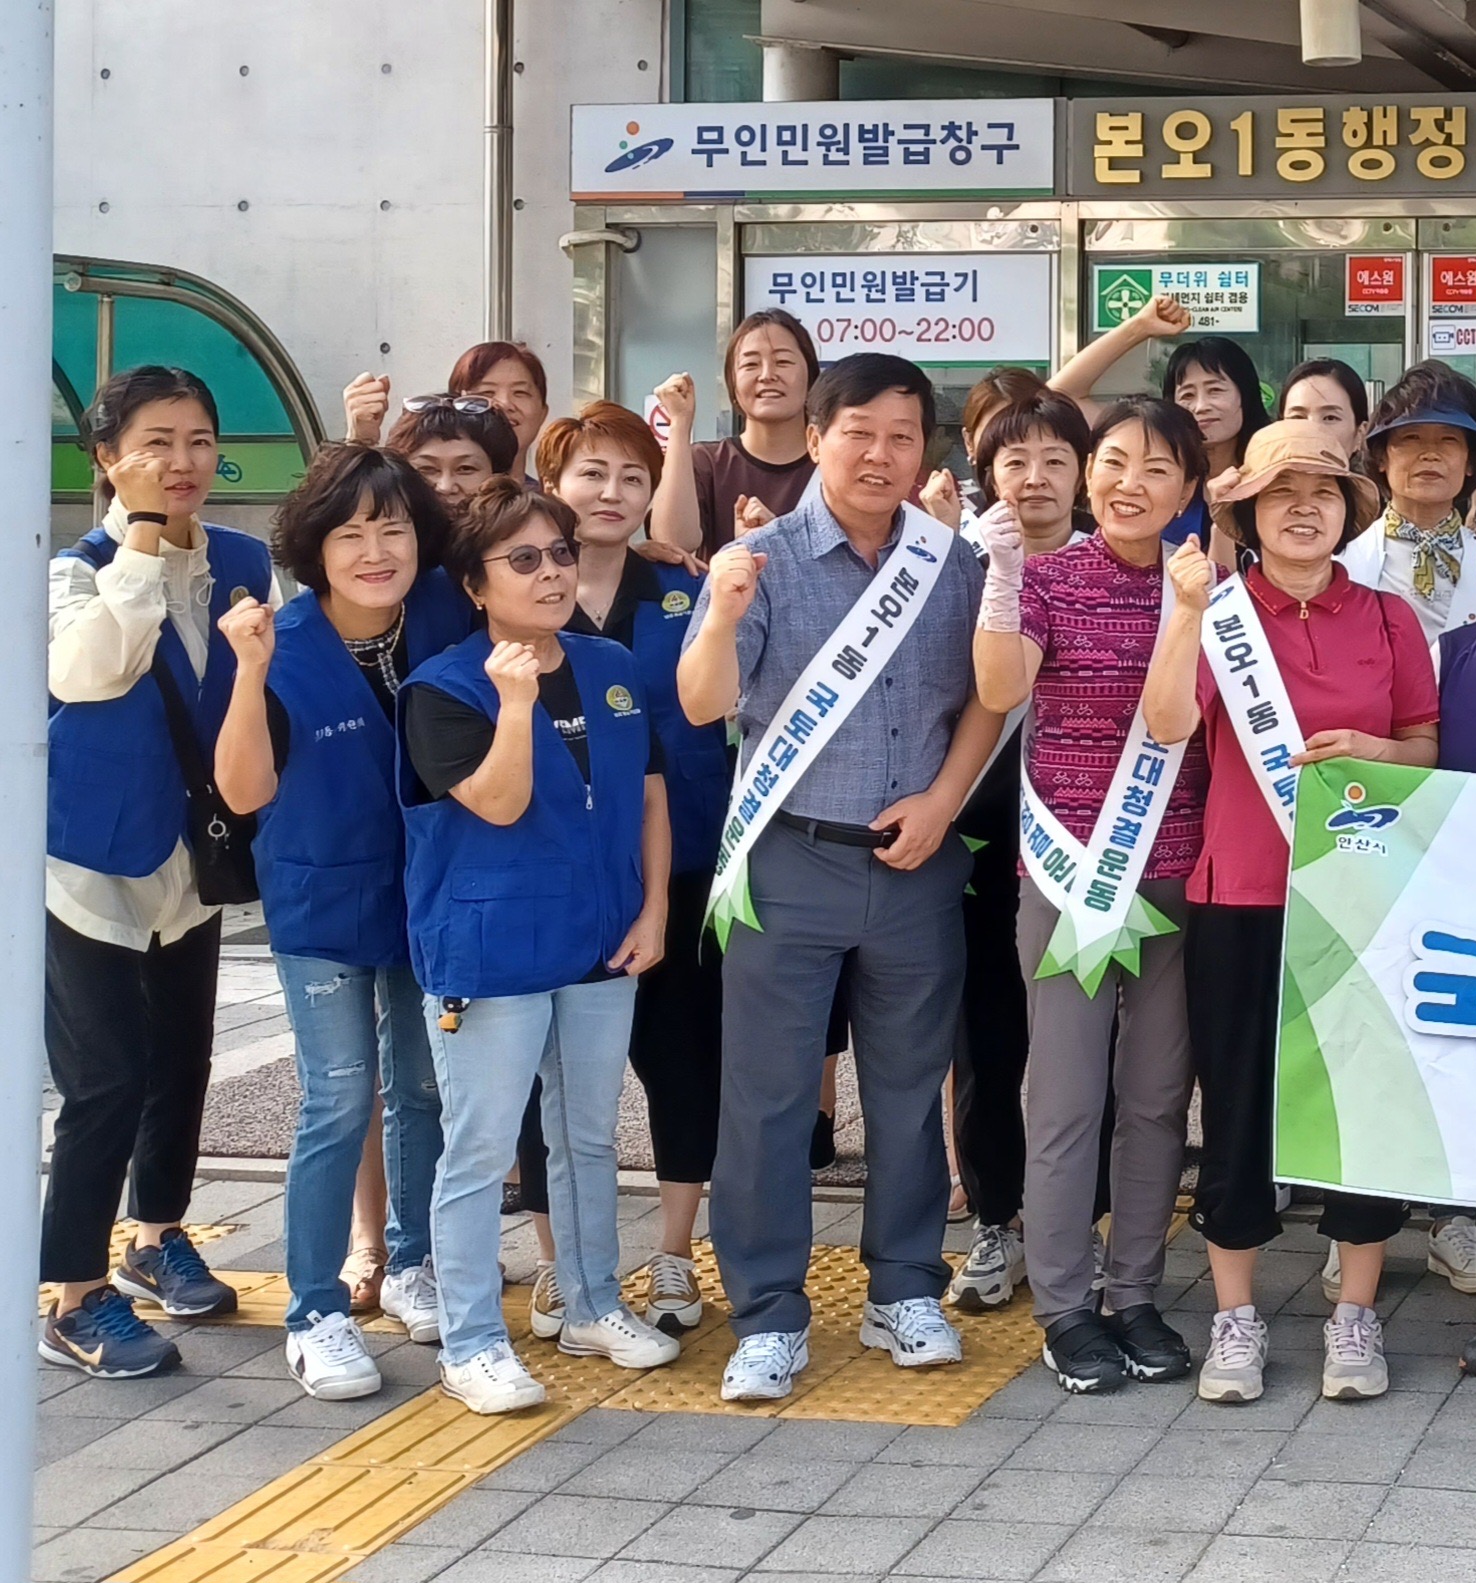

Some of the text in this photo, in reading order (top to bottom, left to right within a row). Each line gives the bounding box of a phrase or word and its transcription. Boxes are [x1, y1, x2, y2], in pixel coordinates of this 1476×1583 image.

[691, 120, 1021, 169] 무인민원발급창구
[768, 268, 980, 305] 무인민원발급기
[1158, 270, 1249, 288] 무더위 쉼터
[1356, 270, 1395, 286] 에스원
[1348, 304, 1380, 313] SECOM
[1432, 305, 1464, 314] SECOM
[816, 316, 996, 344] 07:00~22:00
[831, 566, 920, 681] 본오1동
[1212, 614, 1280, 735] 본오1동
[1083, 730, 1170, 913] 대청결운동
[1336, 835, 1387, 855] 안산시
